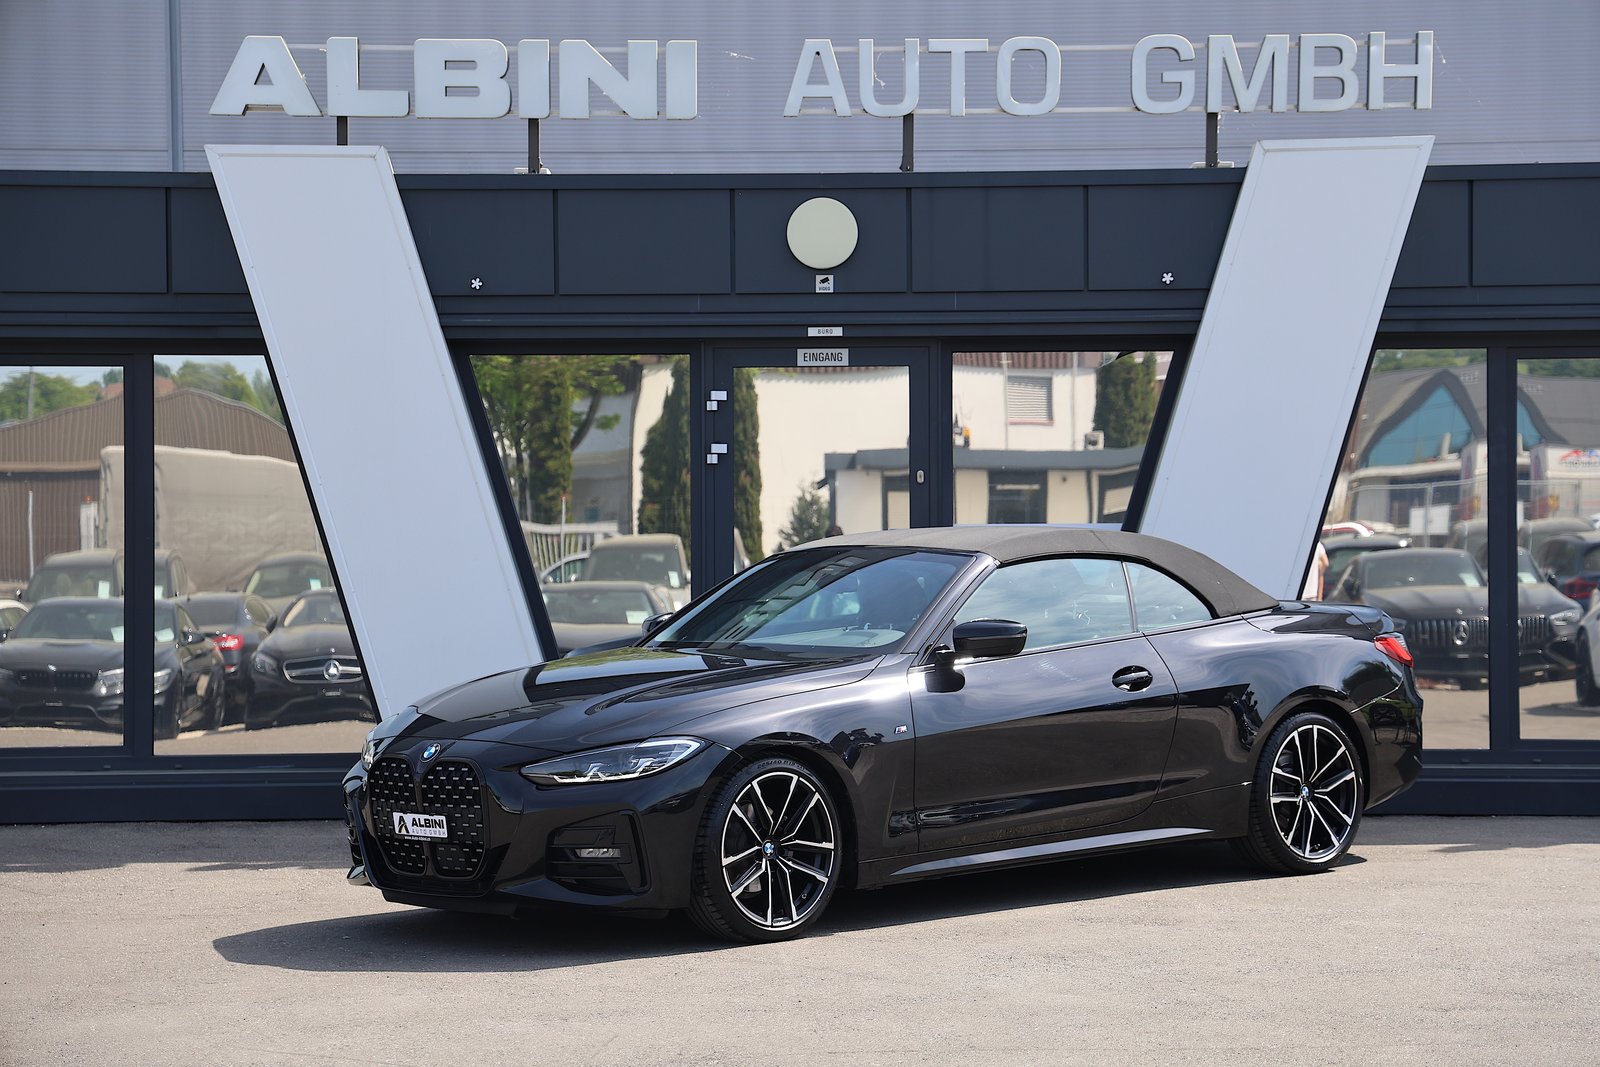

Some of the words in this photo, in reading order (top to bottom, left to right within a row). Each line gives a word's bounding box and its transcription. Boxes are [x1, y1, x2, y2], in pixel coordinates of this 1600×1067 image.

[208, 35, 699, 120] ALBINI
[784, 35, 1062, 118] AUTO
[1130, 30, 1435, 116] GMBH
[803, 352, 843, 362] EINGANG
[412, 818, 444, 829] ALBINI
